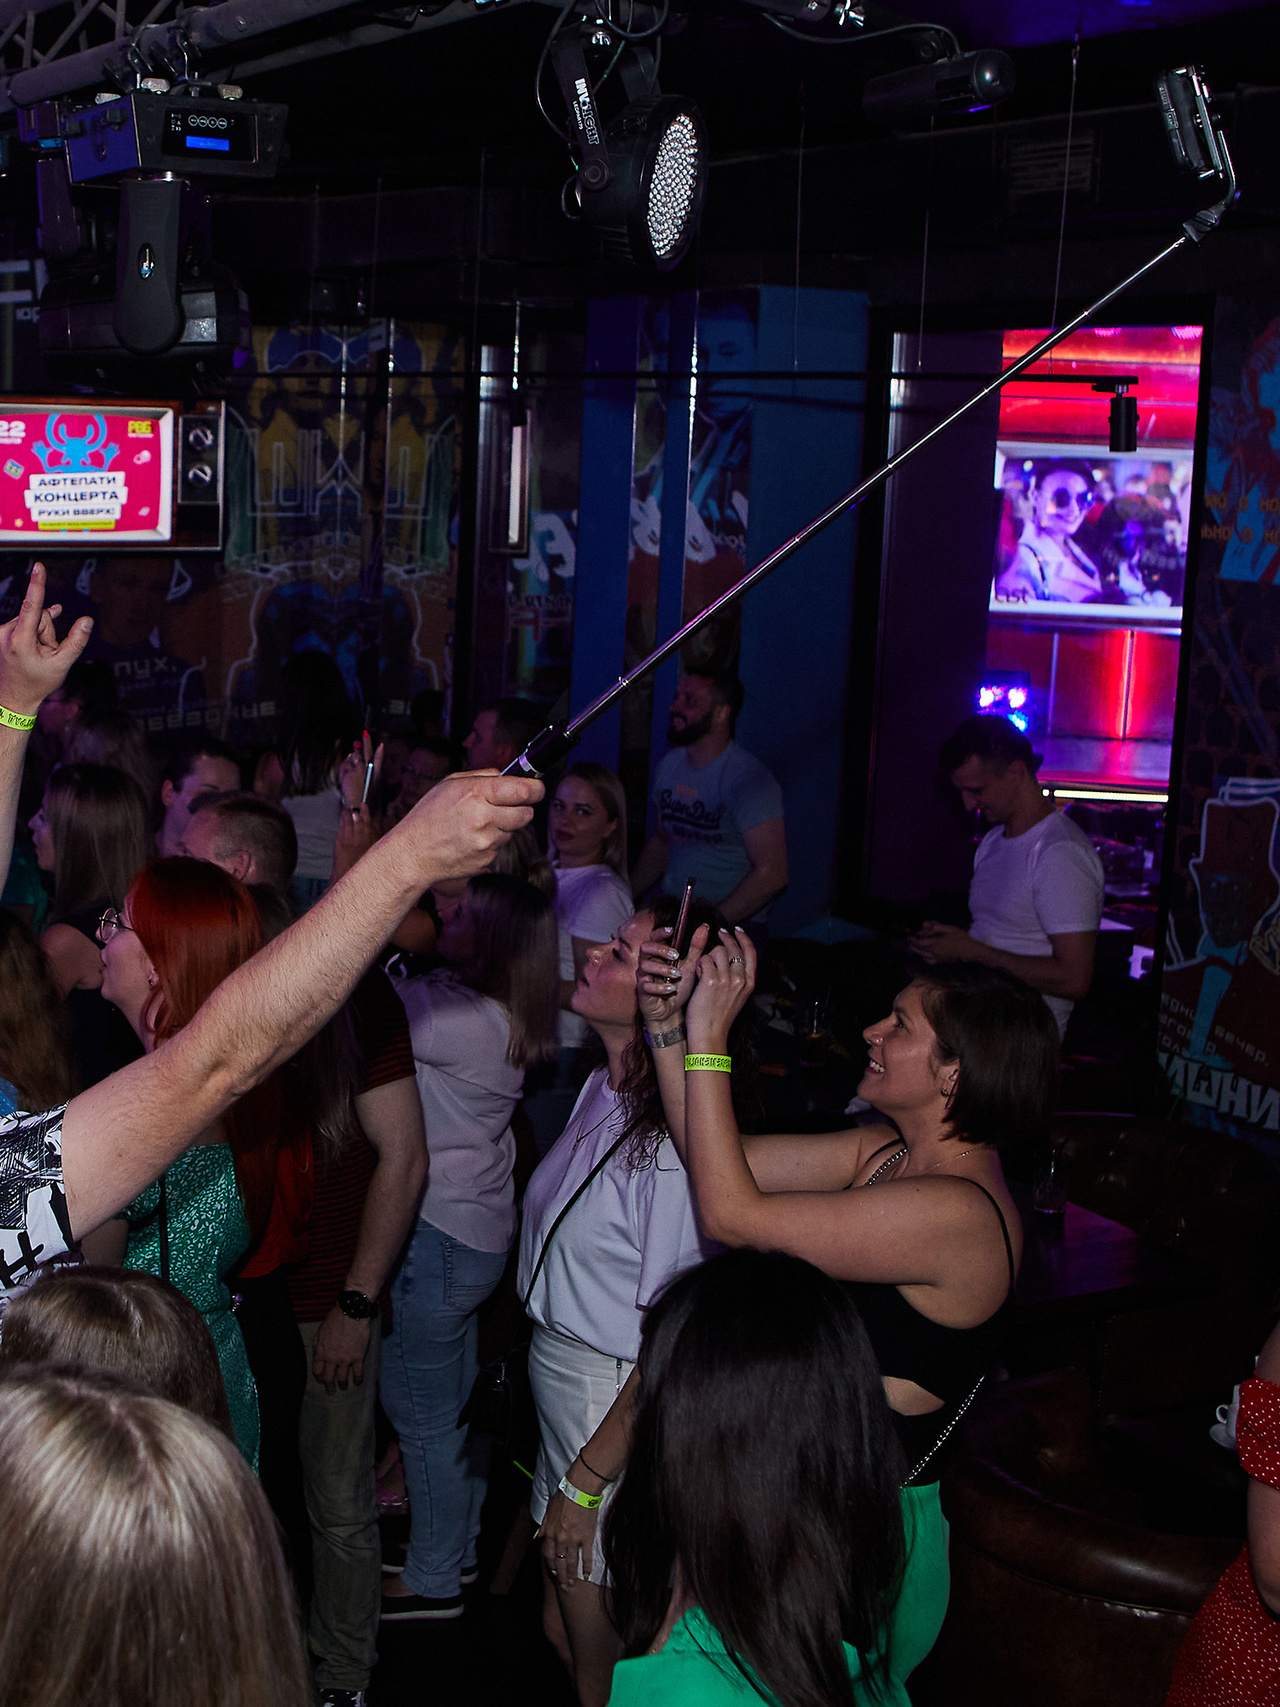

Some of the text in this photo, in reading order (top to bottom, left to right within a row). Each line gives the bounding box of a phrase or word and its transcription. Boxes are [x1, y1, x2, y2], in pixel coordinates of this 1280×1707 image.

[37, 476, 116, 487] АФТЕПАТИ
[34, 491, 119, 504] КОНЦЕРТА
[38, 508, 70, 517] РУКИ
